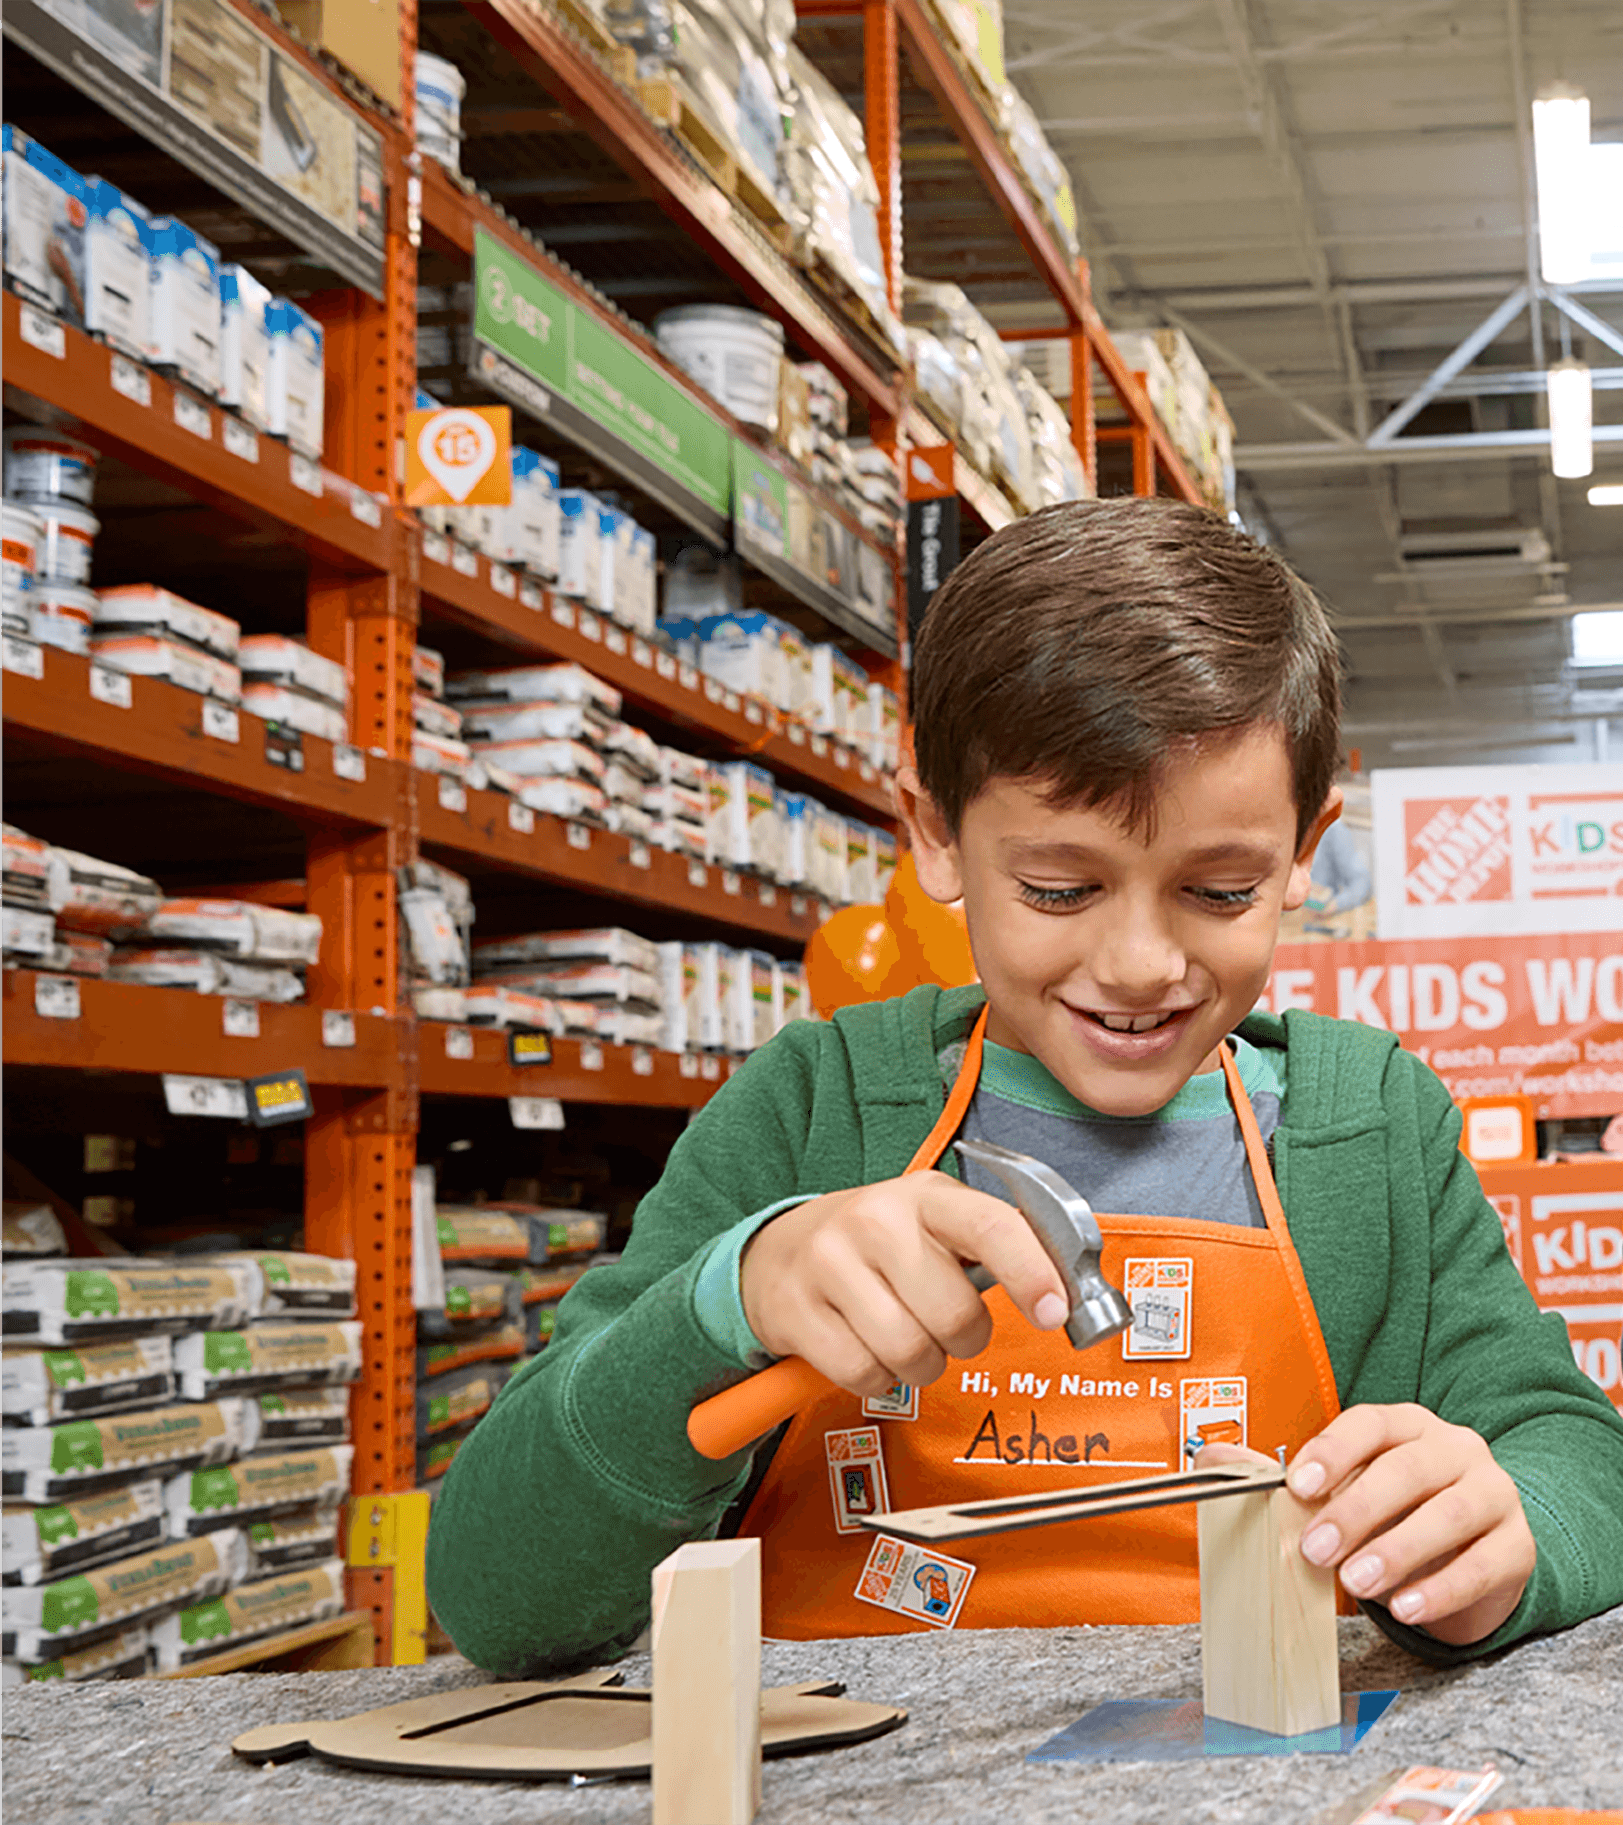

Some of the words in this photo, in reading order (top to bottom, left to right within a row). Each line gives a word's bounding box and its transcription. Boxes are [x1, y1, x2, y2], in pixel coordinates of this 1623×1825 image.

[1411, 801, 1459, 849] THE
[1338, 961, 1508, 1032] KIDS
[1498, 1037, 1580, 1065] month
[960, 1371, 999, 1398] Hi,
[1009, 1372, 1051, 1399] My
[1059, 1374, 1140, 1398] Name
[1149, 1377, 1174, 1398] Is
[964, 1409, 1110, 1465] Asher
